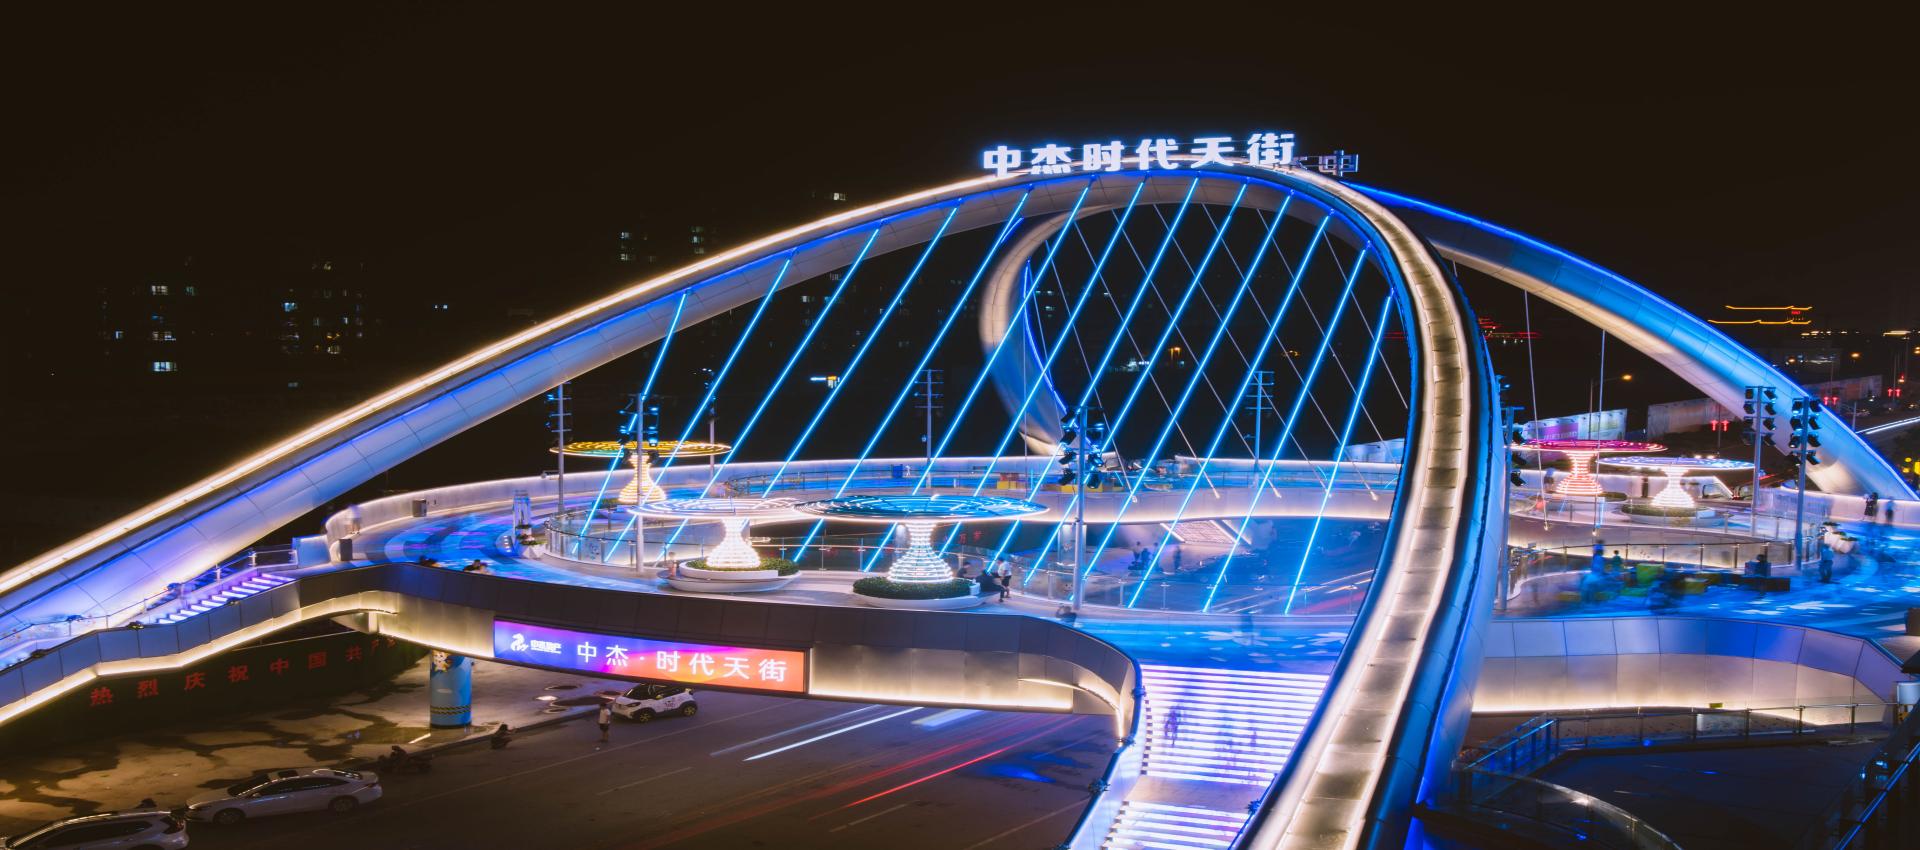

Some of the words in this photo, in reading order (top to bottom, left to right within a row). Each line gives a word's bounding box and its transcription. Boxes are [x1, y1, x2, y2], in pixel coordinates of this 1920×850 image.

[982, 132, 1296, 178] 中杰时代天街
